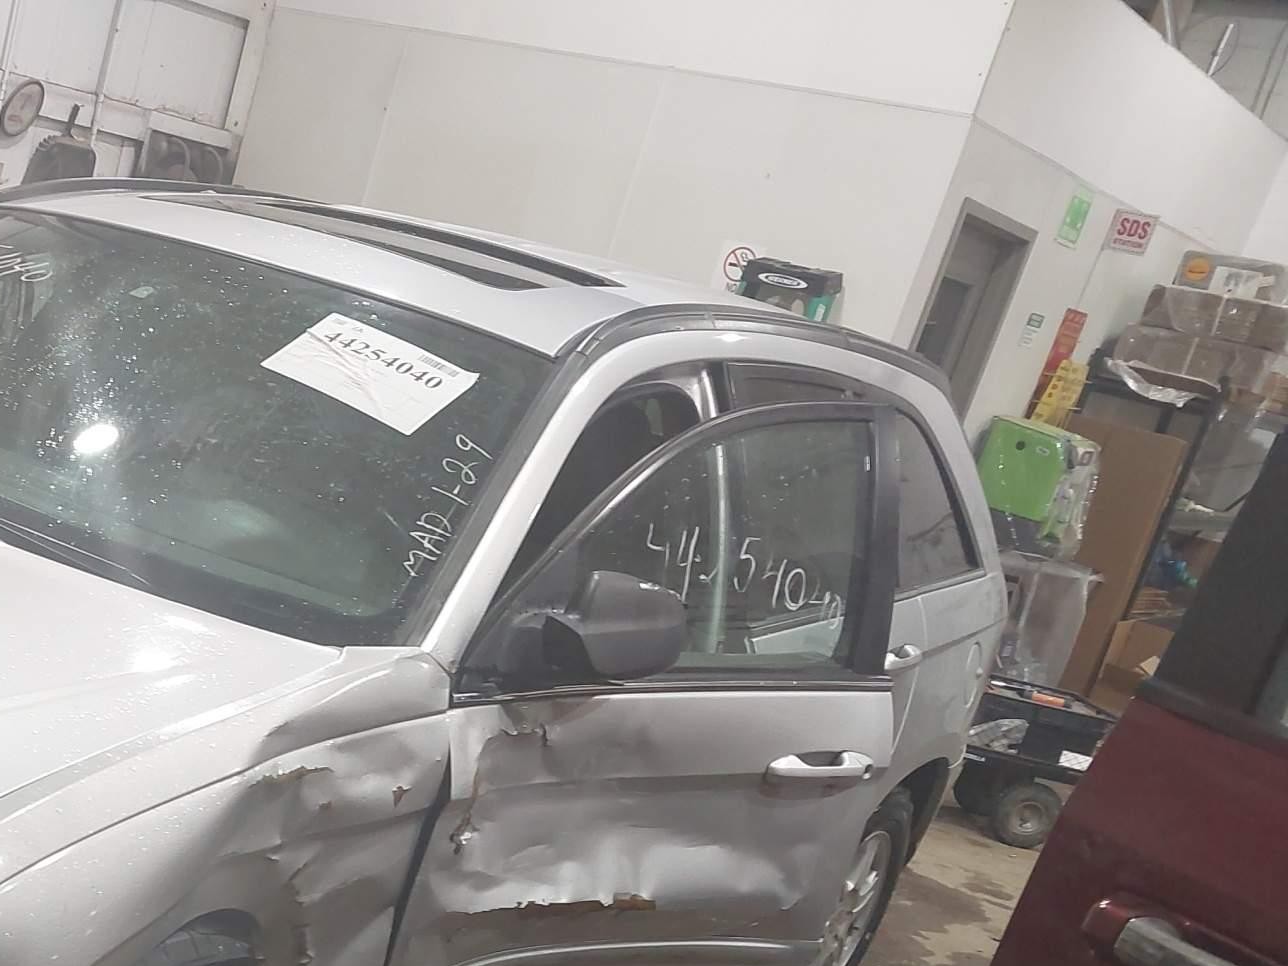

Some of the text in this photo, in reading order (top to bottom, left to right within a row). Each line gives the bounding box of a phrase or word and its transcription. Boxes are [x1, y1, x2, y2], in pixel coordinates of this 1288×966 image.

[1117, 217, 1152, 240] SDS
[323, 331, 443, 390] 44254040
[402, 512, 453, 577] MAD
